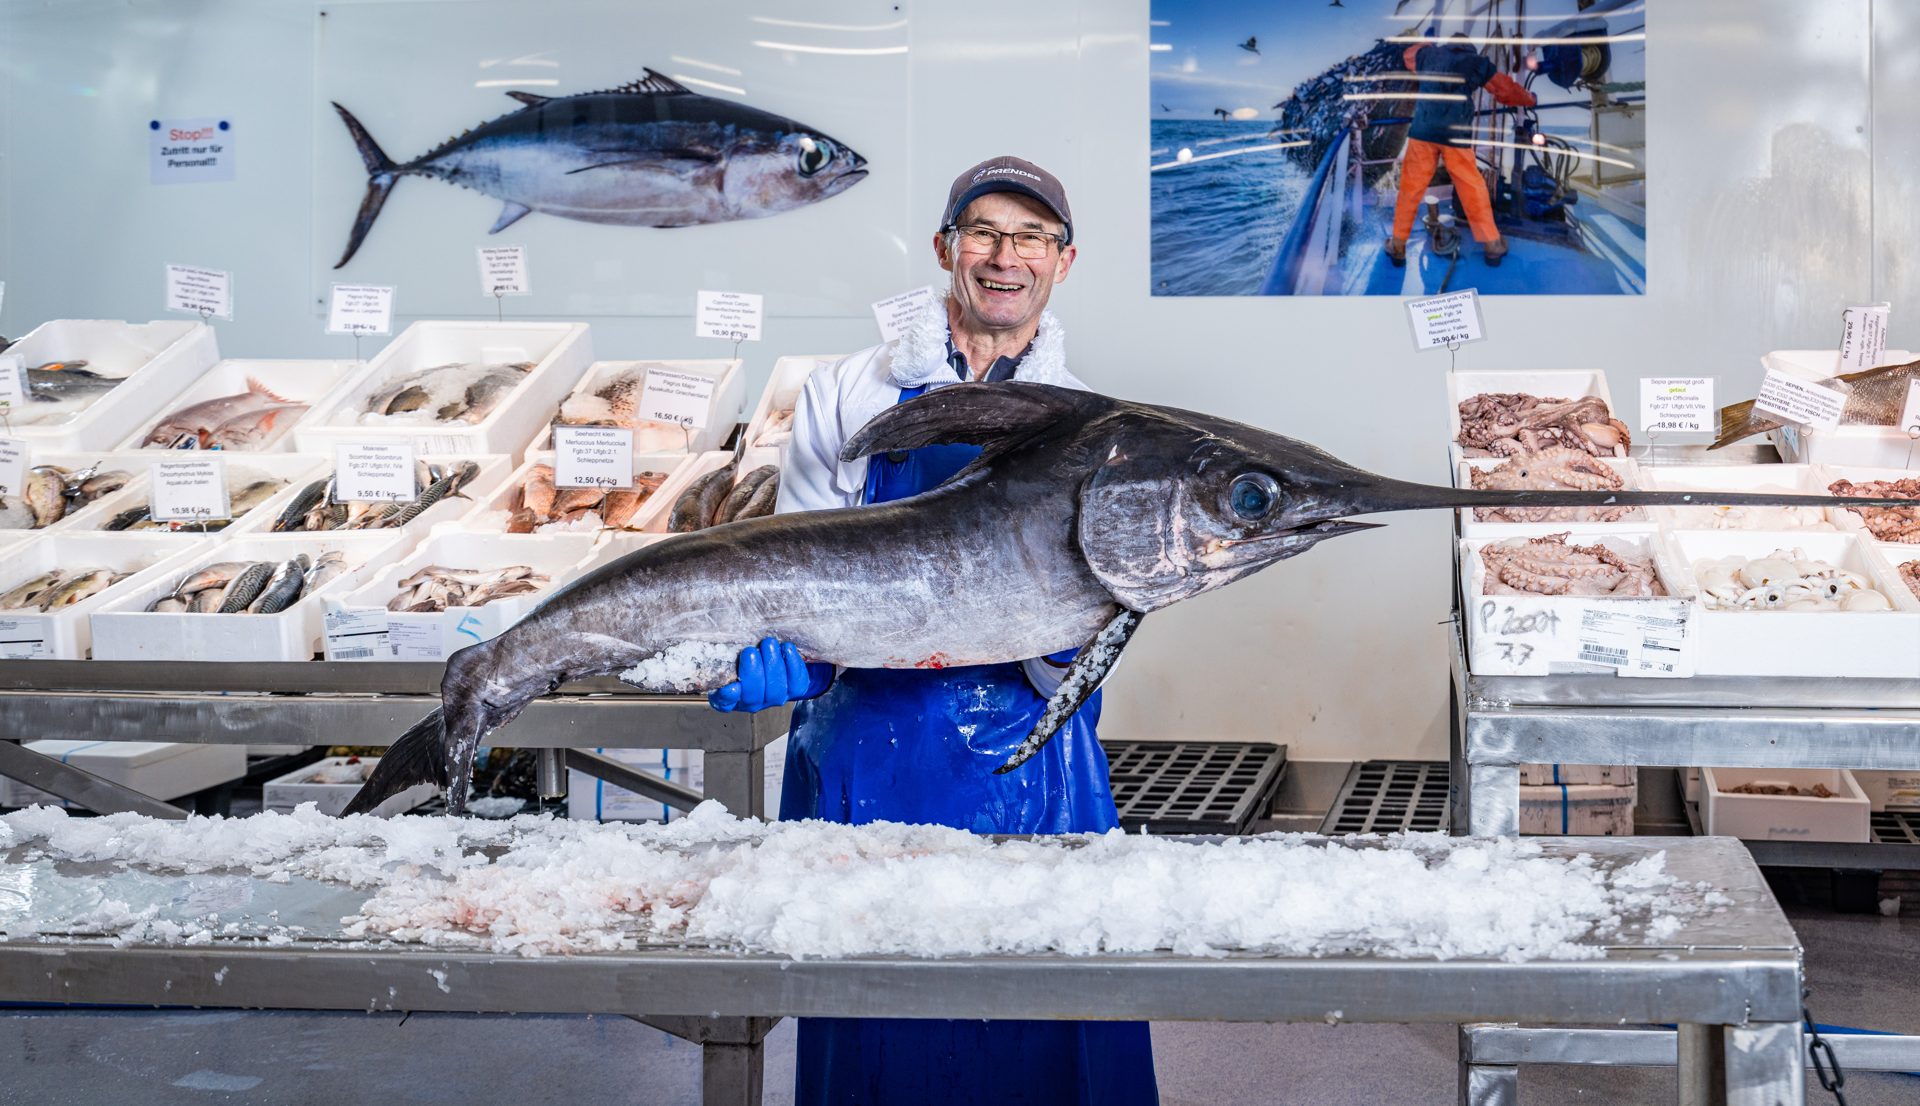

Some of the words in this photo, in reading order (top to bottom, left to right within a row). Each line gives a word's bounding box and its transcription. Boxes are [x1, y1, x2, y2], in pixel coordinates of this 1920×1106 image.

[160, 146, 190, 156] Zutritt
[209, 145, 224, 154] für
[1432, 335, 1450, 345] 25,90
[1843, 350, 1850, 360] kg
[648, 385, 674, 394] Aquakultur
[1758, 399, 1789, 412] KREBSTIERE
[654, 412, 672, 421] 16,50
[684, 416, 693, 424] kg
[1805, 409, 1821, 417] FISCH
[607, 477, 617, 486] kg
